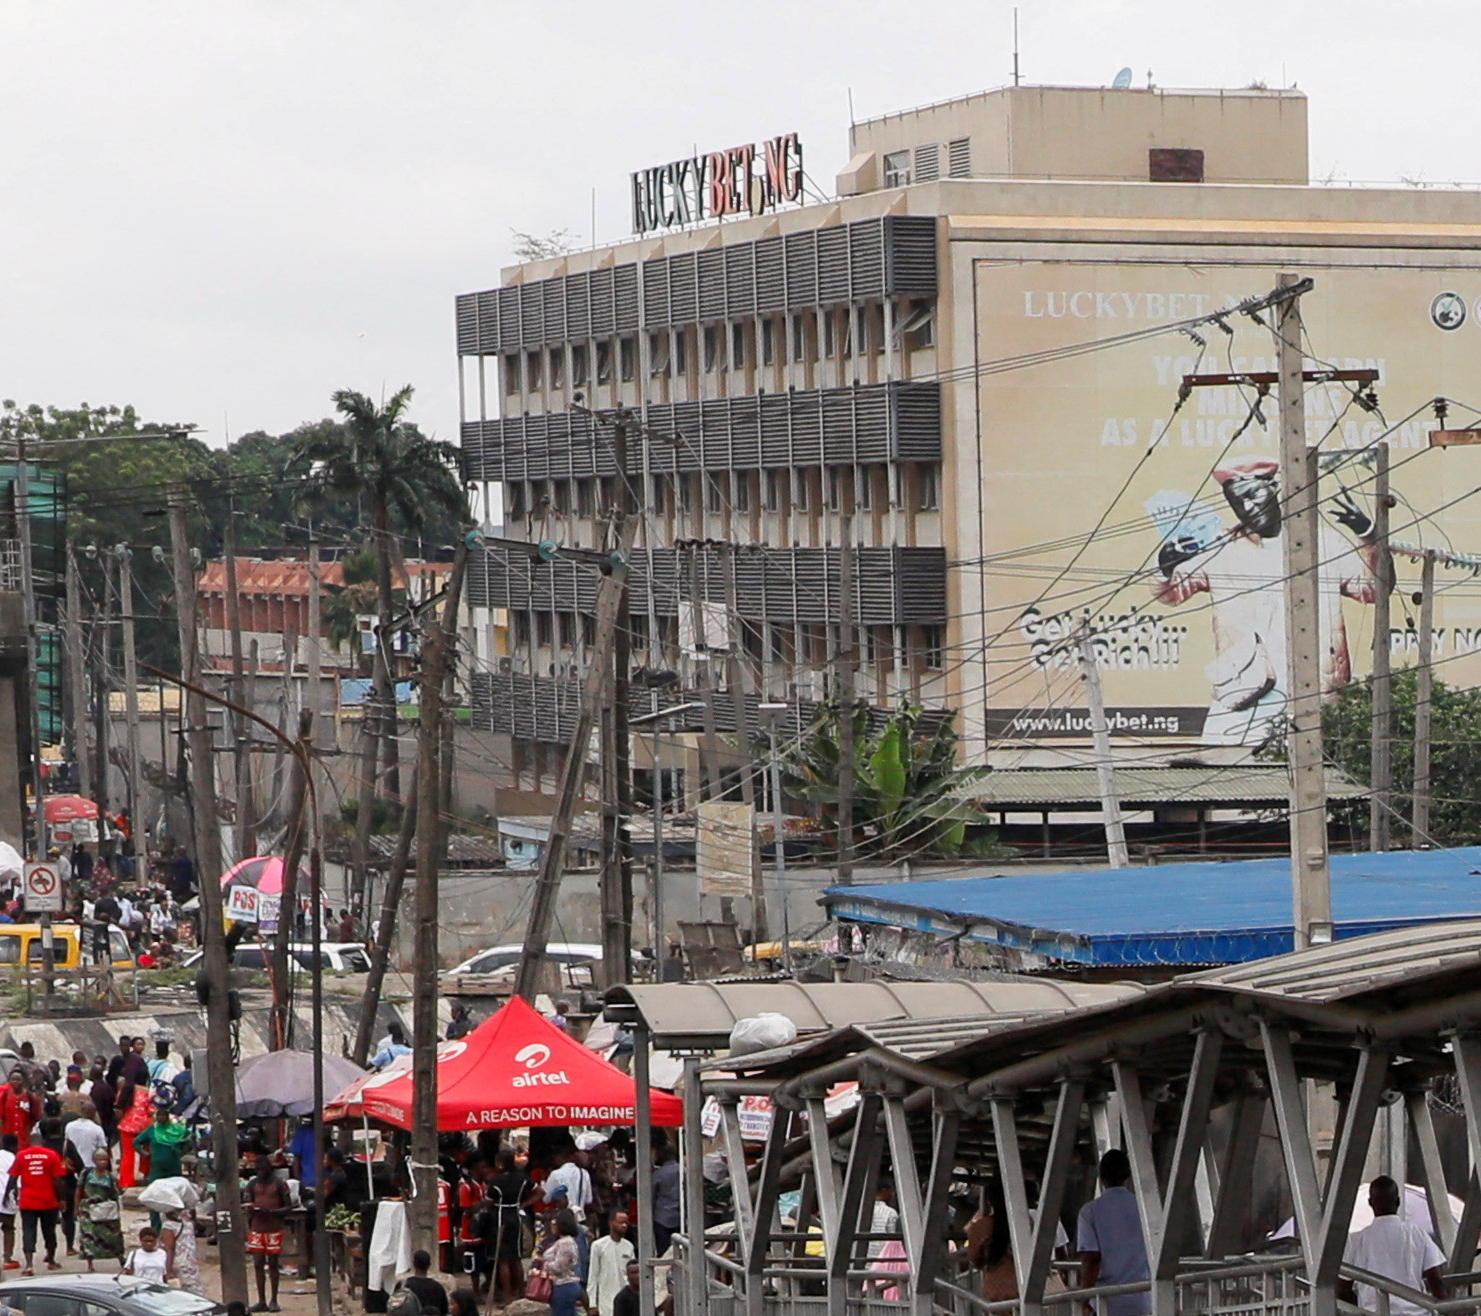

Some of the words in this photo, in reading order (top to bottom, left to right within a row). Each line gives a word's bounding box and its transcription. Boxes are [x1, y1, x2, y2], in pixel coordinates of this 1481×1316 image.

[1101, 419, 1137, 446] AS
[1181, 418, 1331, 448] LUCKYET
[1013, 711, 1179, 733] www.lucybet.ng
[232, 890, 256, 910] POS
[512, 1070, 570, 1088] airtel
[466, 1111, 478, 1124] A
[480, 1107, 543, 1123] REASON
[546, 1105, 567, 1119] TO
[570, 1106, 635, 1120] IMAGINE
